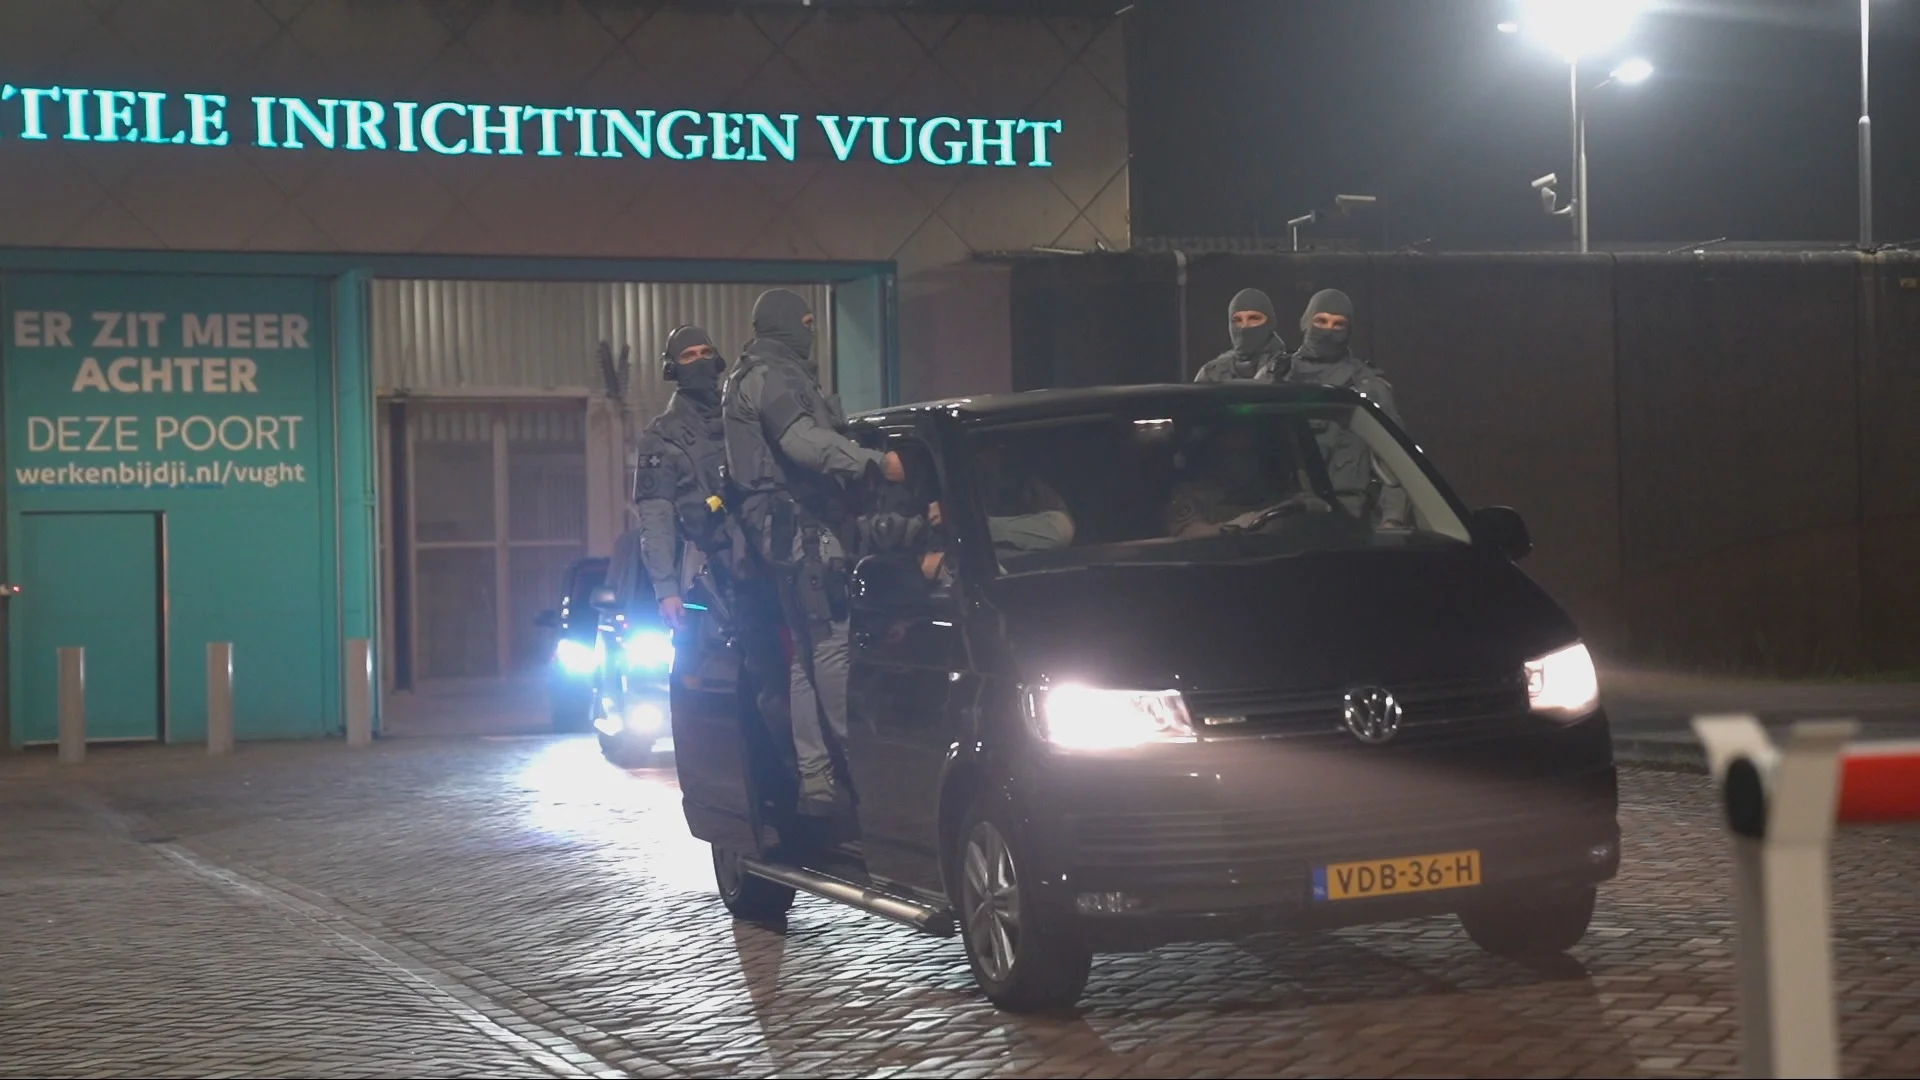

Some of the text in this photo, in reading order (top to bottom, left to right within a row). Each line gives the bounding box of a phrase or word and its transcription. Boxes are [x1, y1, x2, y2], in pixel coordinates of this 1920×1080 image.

[2, 84, 1062, 168] TIELE INRICHTINGEN VUGHT
[13, 311, 310, 348] ER ZIT MEER
[72, 357, 259, 393] ACHTER
[27, 415, 304, 452] DEZE POORT
[15, 460, 305, 488] werkenbijdji.nl/vught
[1336, 855, 1473, 895] VDB-36-H
